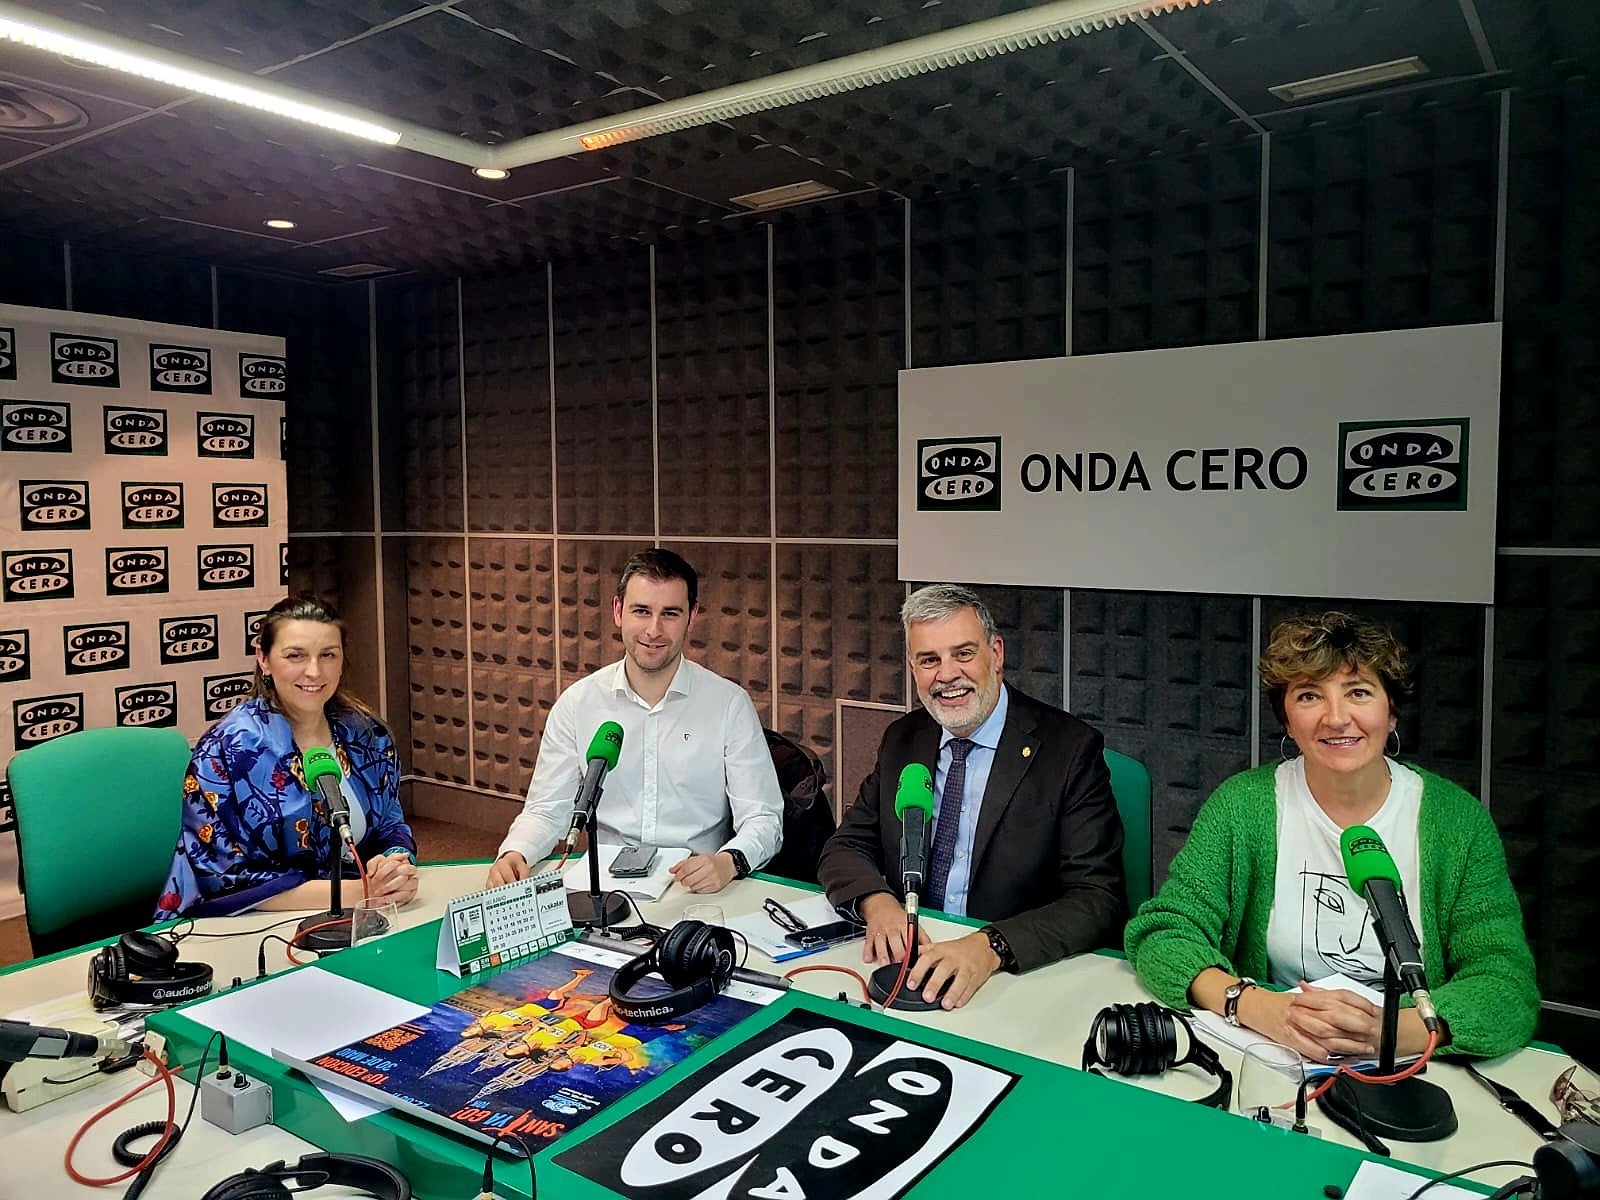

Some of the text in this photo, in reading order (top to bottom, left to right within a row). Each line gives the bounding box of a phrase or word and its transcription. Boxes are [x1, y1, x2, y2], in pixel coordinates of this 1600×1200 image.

[62, 345, 107, 358] ONDA
[160, 356, 201, 367] ONDA
[66, 363, 108, 376] CERO
[248, 365, 284, 375] ONDA
[163, 372, 201, 383] CERO
[250, 380, 284, 390] CERO
[11, 412, 58, 423] ONDA
[115, 417, 156, 429] ONDA
[207, 423, 244, 433] ONDA
[15, 430, 59, 441] CERO
[118, 434, 156, 445] CERO
[209, 438, 243, 449] CERO
[1359, 441, 1443, 461] ONDA
[930, 456, 985, 469] ONDA
[1019, 446, 1308, 493] ONDA CERO
[933, 479, 985, 494] CERO
[1363, 470, 1443, 491] CERO
[31, 491, 78, 502] ONDA
[132, 493, 173, 503] ONDA
[222, 493, 259, 503] ONDA
[35, 508, 78, 520] CERO
[135, 508, 173, 519] CERO
[224, 508, 259, 518] CERO
[116, 557, 158, 568] ONDA
[206, 554, 244, 564] ONDA
[14, 561, 61, 573] ONDA
[119, 573, 157, 584] CERO
[209, 569, 244, 580] CERO
[18, 577, 62, 590] CERO
[169, 625, 209, 638] ONDA
[75, 633, 118, 646] ONDA
[172, 640, 208, 654] CERO
[79, 650, 118, 663] CERO
[214, 682, 249, 694] ONDA
[125, 693, 167, 707] ONDA
[215, 697, 242, 709] CER
[25, 705, 71, 721] ONDA
[129, 707, 166, 722] CERO
[29, 722, 71, 737] CERO
[654, 1047, 835, 1165] CERO
[748, 1070, 942, 1200] ONDA
